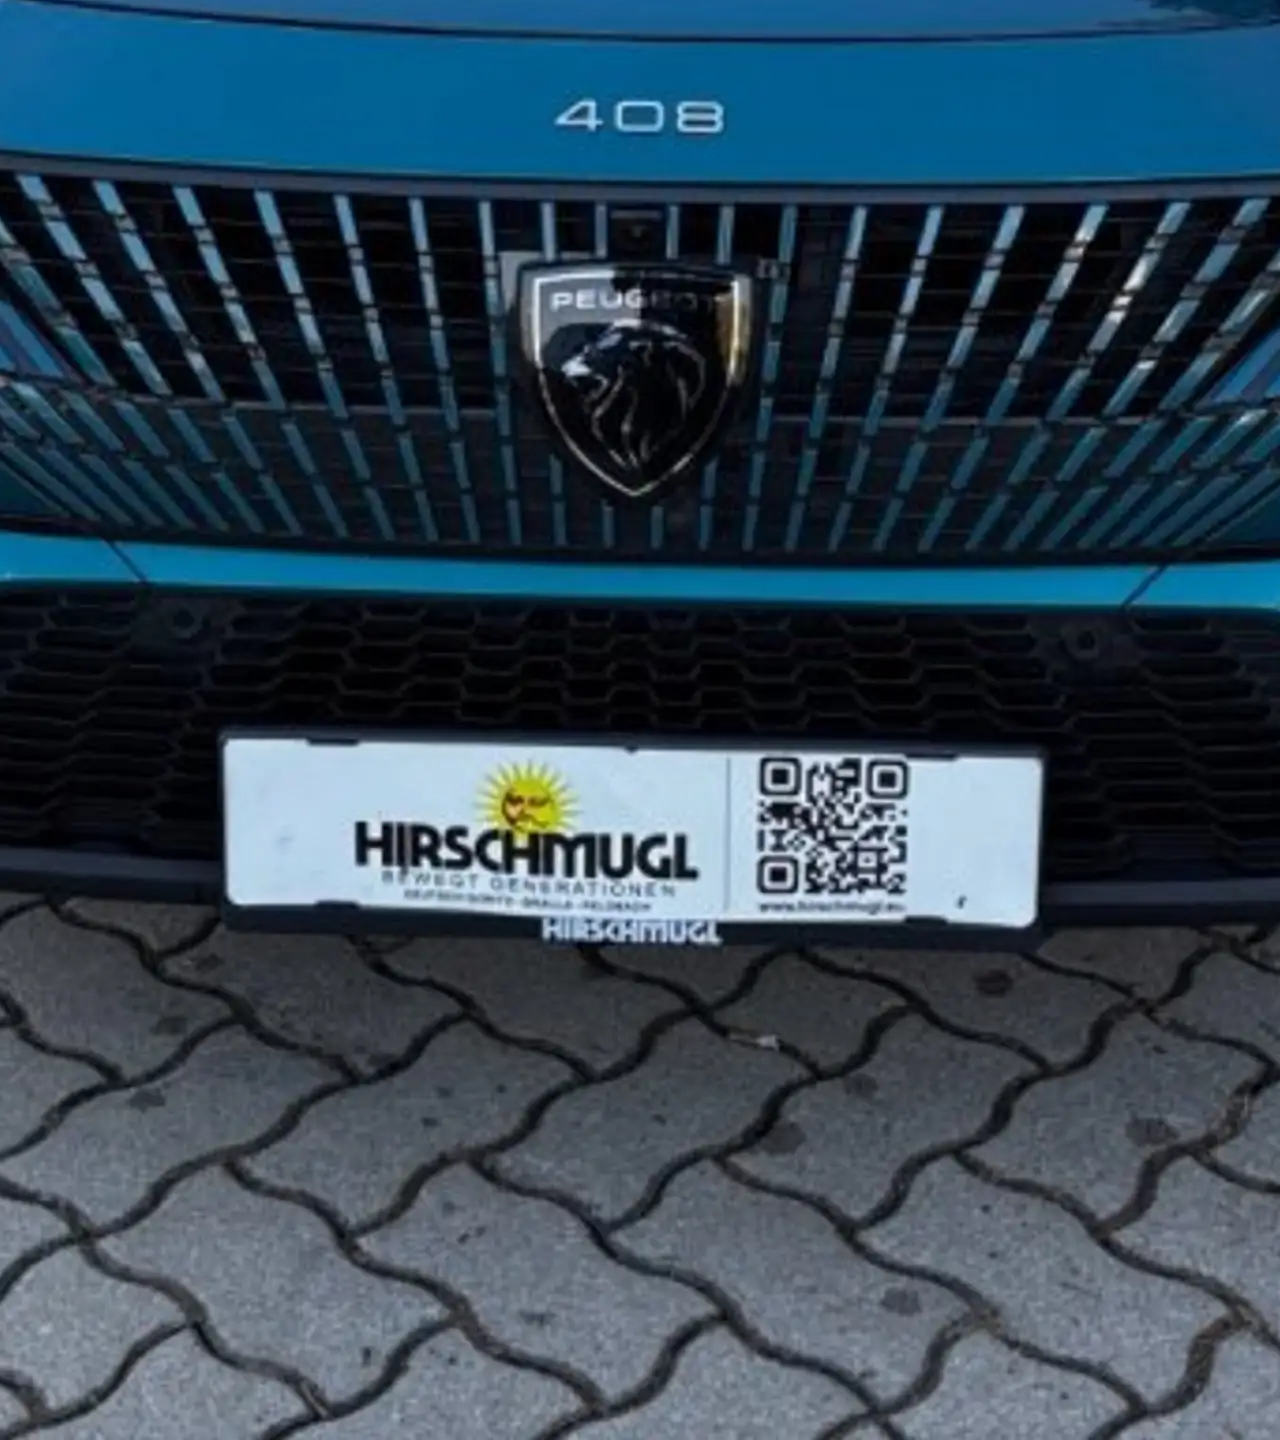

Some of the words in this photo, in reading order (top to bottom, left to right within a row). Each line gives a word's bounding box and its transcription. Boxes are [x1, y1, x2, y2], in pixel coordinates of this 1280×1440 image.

[554, 98, 725, 134] 408
[354, 821, 700, 881] HIRSCHMUGL
[381, 869, 479, 889] BEWEGT
[489, 873, 676, 899] GENERATIONEN
[541, 916, 722, 945] HIRSCHMUGL
